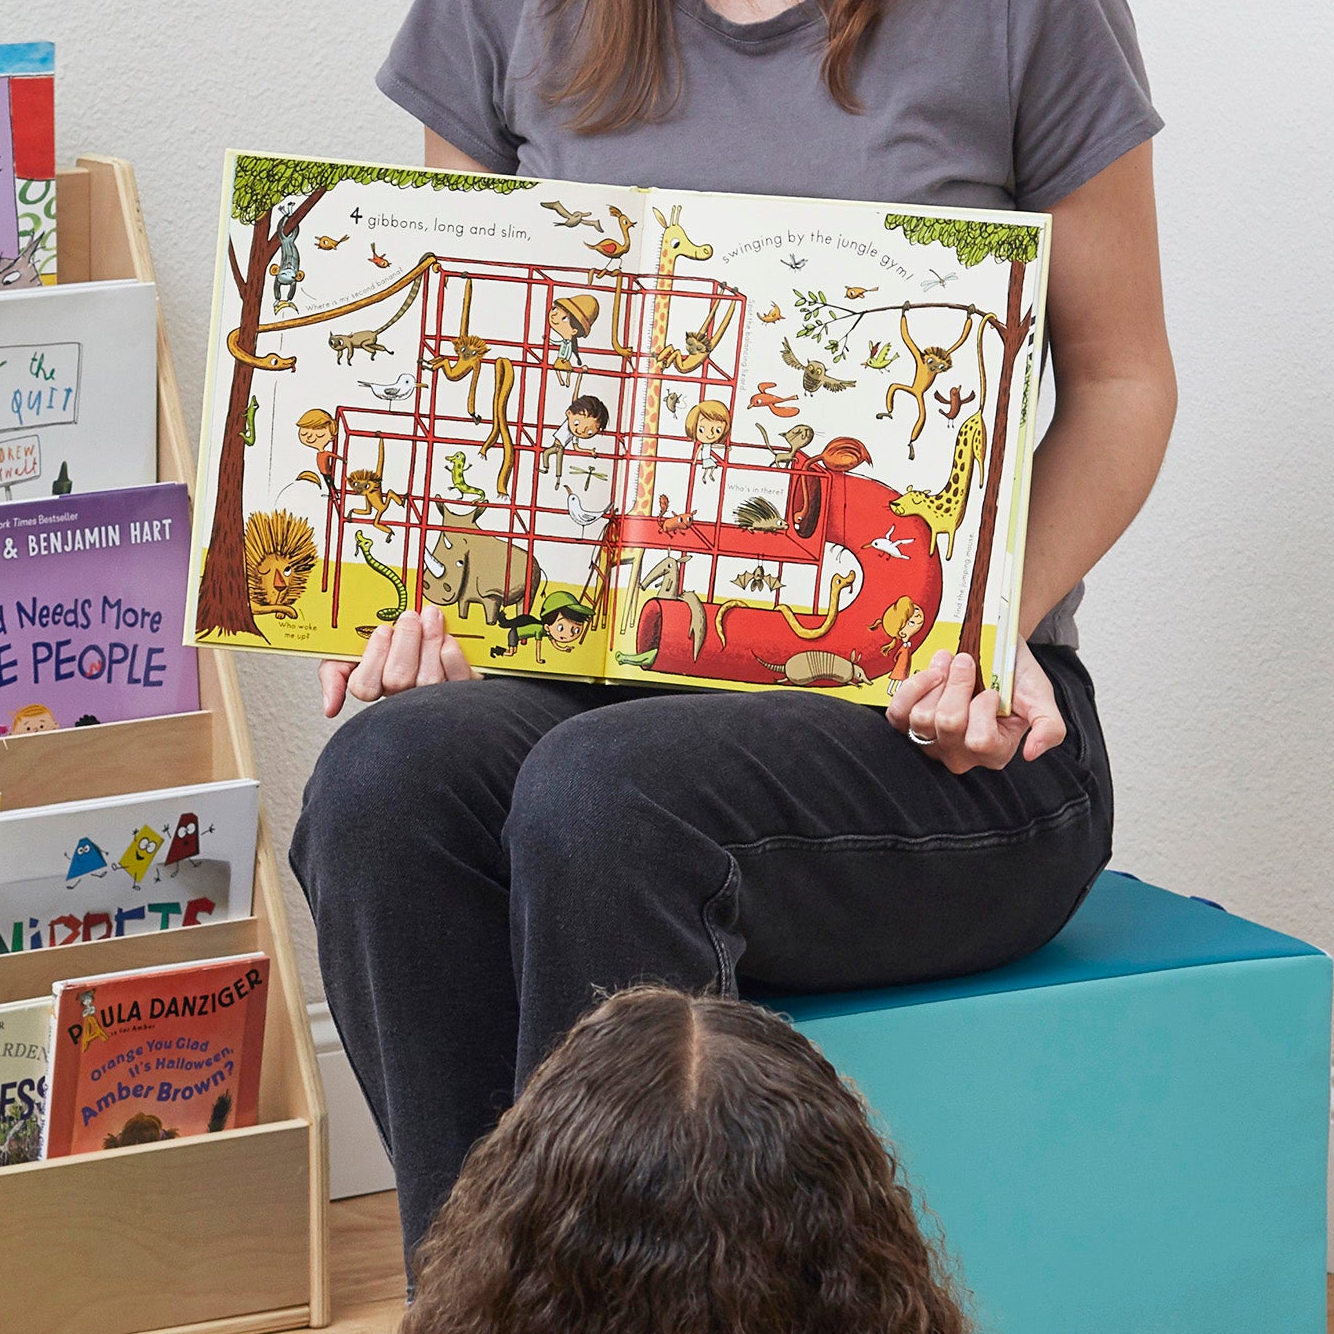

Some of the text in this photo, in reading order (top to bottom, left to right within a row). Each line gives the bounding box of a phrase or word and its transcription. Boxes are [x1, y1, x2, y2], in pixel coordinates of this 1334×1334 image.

[350, 207, 532, 241] 4 gibbons, long and slim,
[722, 230, 914, 280] swinging by the jungle gym!
[305, 302, 331, 312] Where
[339, 295, 350, 304] my
[351, 284, 376, 299] second
[29, 351, 56, 381] the
[11, 387, 73, 425] QUIT
[3, 538, 18, 559] &
[28, 524, 121, 557] BENJAMIN
[130, 519, 173, 544] HART
[13, 517, 37, 528] Times
[38, 512, 79, 525] Bestseller
[101, 595, 163, 633] More
[278, 621, 317, 631] Who woke
[32, 639, 167, 687] PEOPLE
[67, 1001, 142, 1053] PAULA
[150, 968, 263, 1019] DANZIGER
[91, 1037, 209, 1082] Orange You Glad
[128, 1046, 234, 1079] It's Halloween,
[80, 1061, 235, 1127] Amber Brown?
